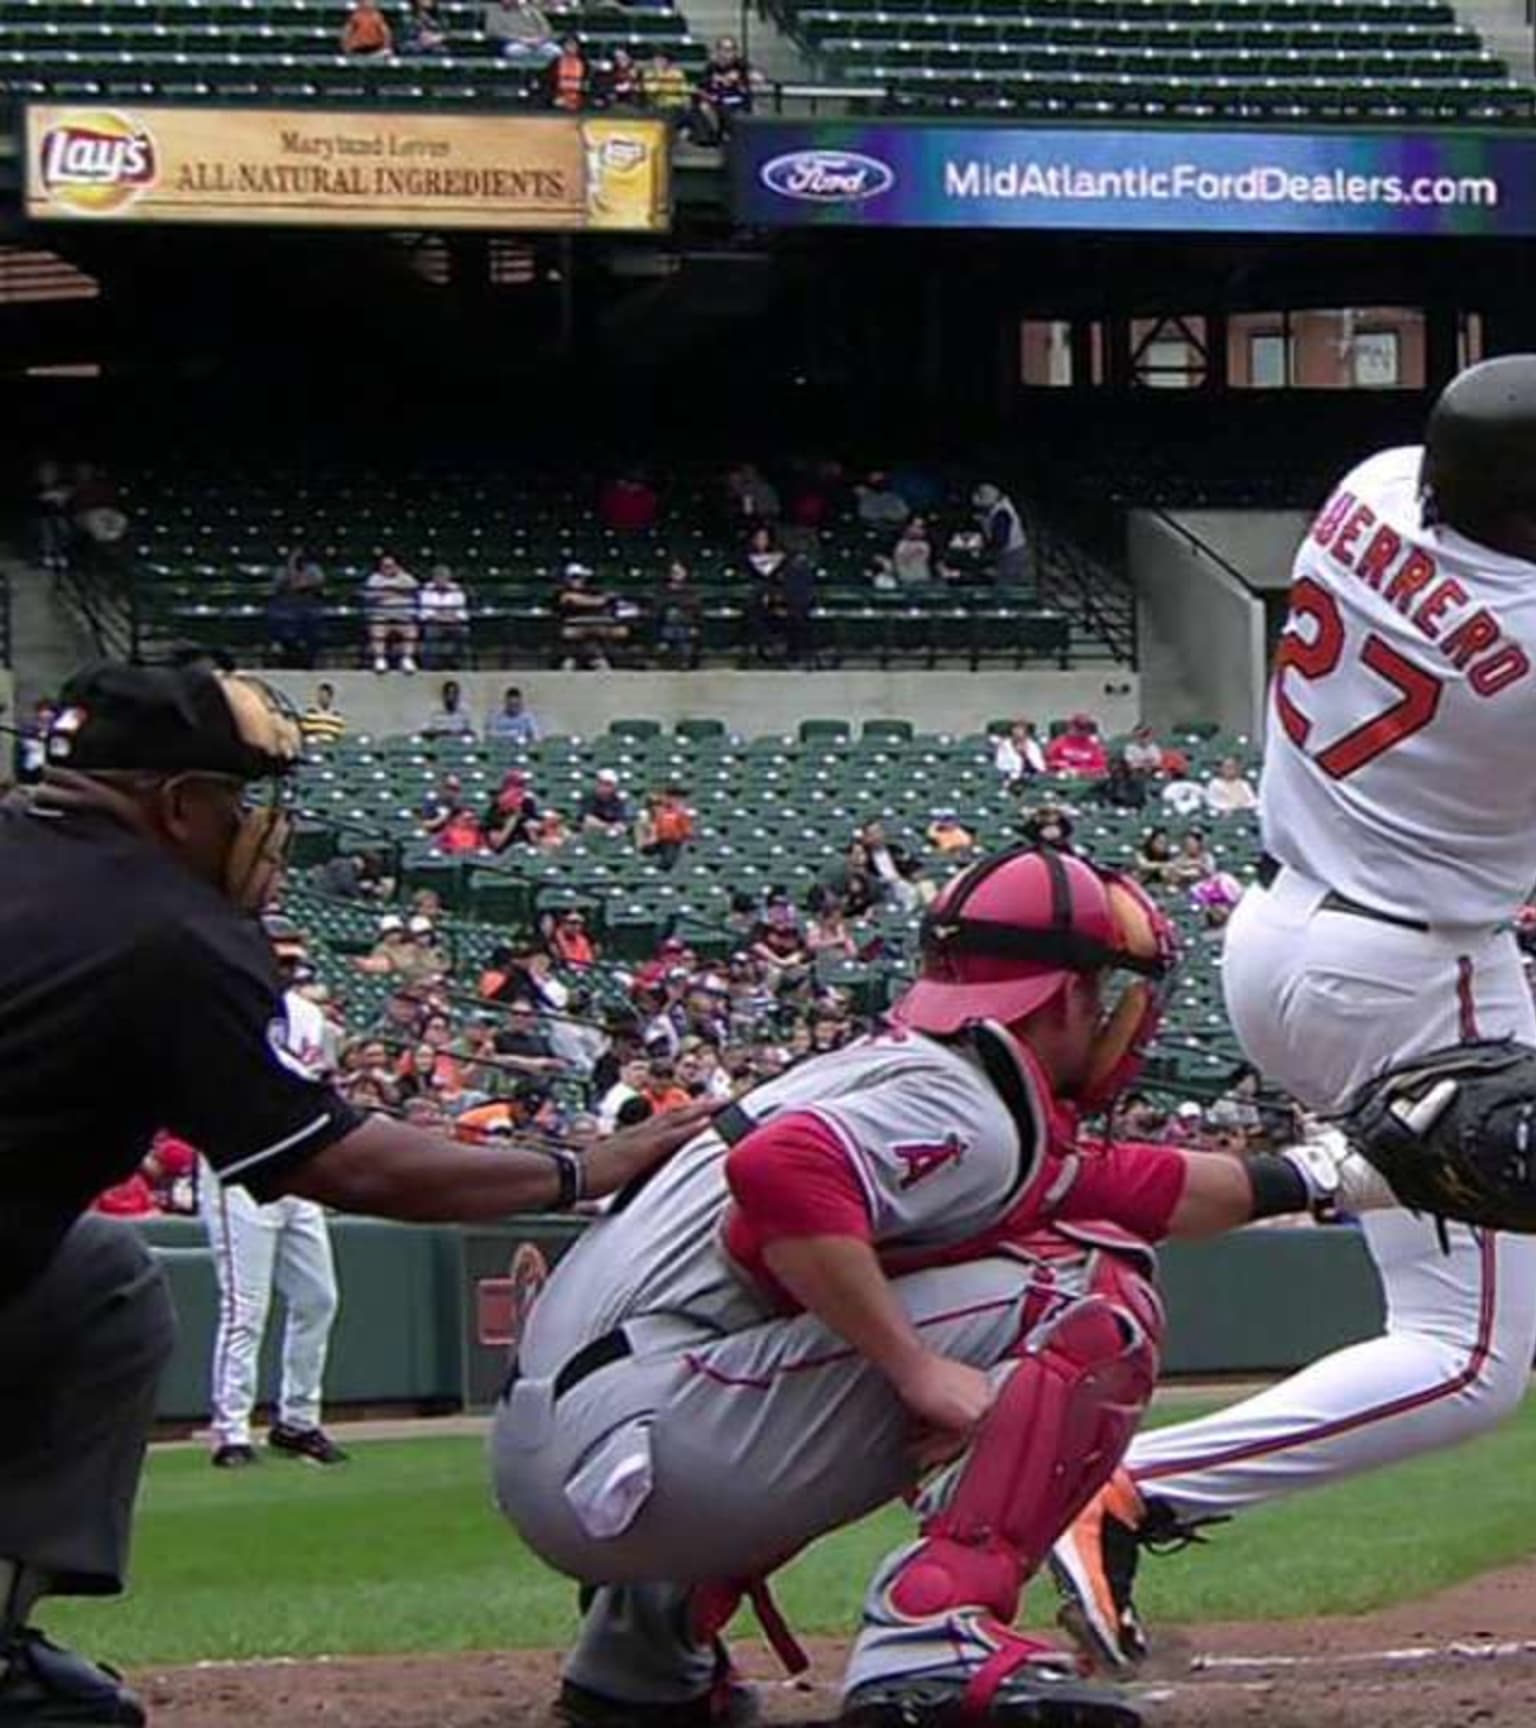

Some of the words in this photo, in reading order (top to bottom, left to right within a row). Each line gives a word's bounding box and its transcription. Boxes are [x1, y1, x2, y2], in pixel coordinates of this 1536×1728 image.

[178, 164, 234, 192] ALL
[238, 165, 370, 195] NATURAL
[375, 168, 565, 199] INGREDIENTS
[787, 155, 867, 193] Ford
[945, 160, 1498, 204] MidAtlanticFordDealers.com
[1313, 491, 1532, 699] UERRERO
[1276, 575, 1445, 781] 27
[892, 1134, 966, 1190] A
